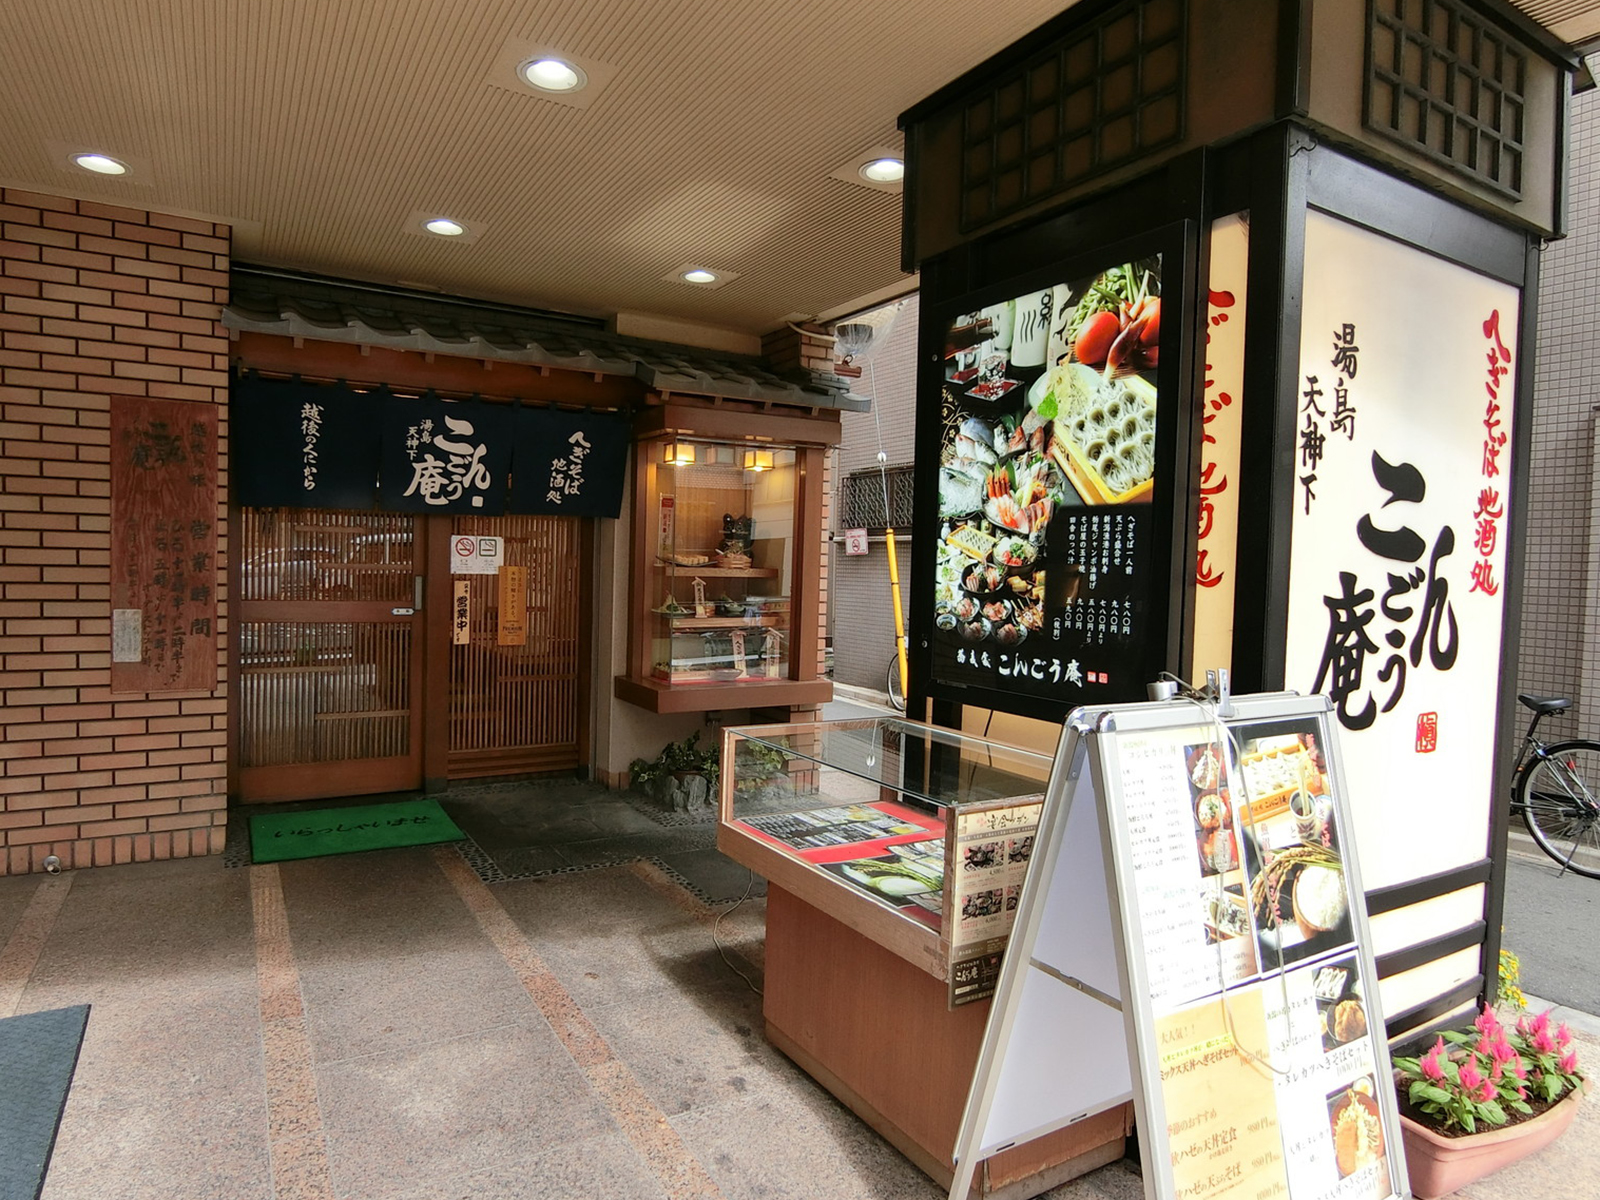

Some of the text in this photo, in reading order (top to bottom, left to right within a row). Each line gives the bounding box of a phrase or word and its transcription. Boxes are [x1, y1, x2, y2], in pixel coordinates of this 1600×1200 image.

[1330, 323, 1359, 441] 湯島
[301, 402, 324, 490] 越後のくにから
[406, 426, 419, 460] 天神下
[420, 419, 435, 444] 湯島
[1299, 375, 1326, 515] 天神下
[1469, 309, 1511, 596] へぎそば 地酒処
[546, 457, 567, 504] 地酒処
[564, 431, 592, 495] へぎそば
[1125, 515, 1136, 575] へぎそば一人前
[190, 519, 212, 638] 営業時間
[457, 595, 468, 632] 営業中
[998, 652, 1083, 688] こんごう庵
[274, 815, 431, 839] いらっしゃいませ
